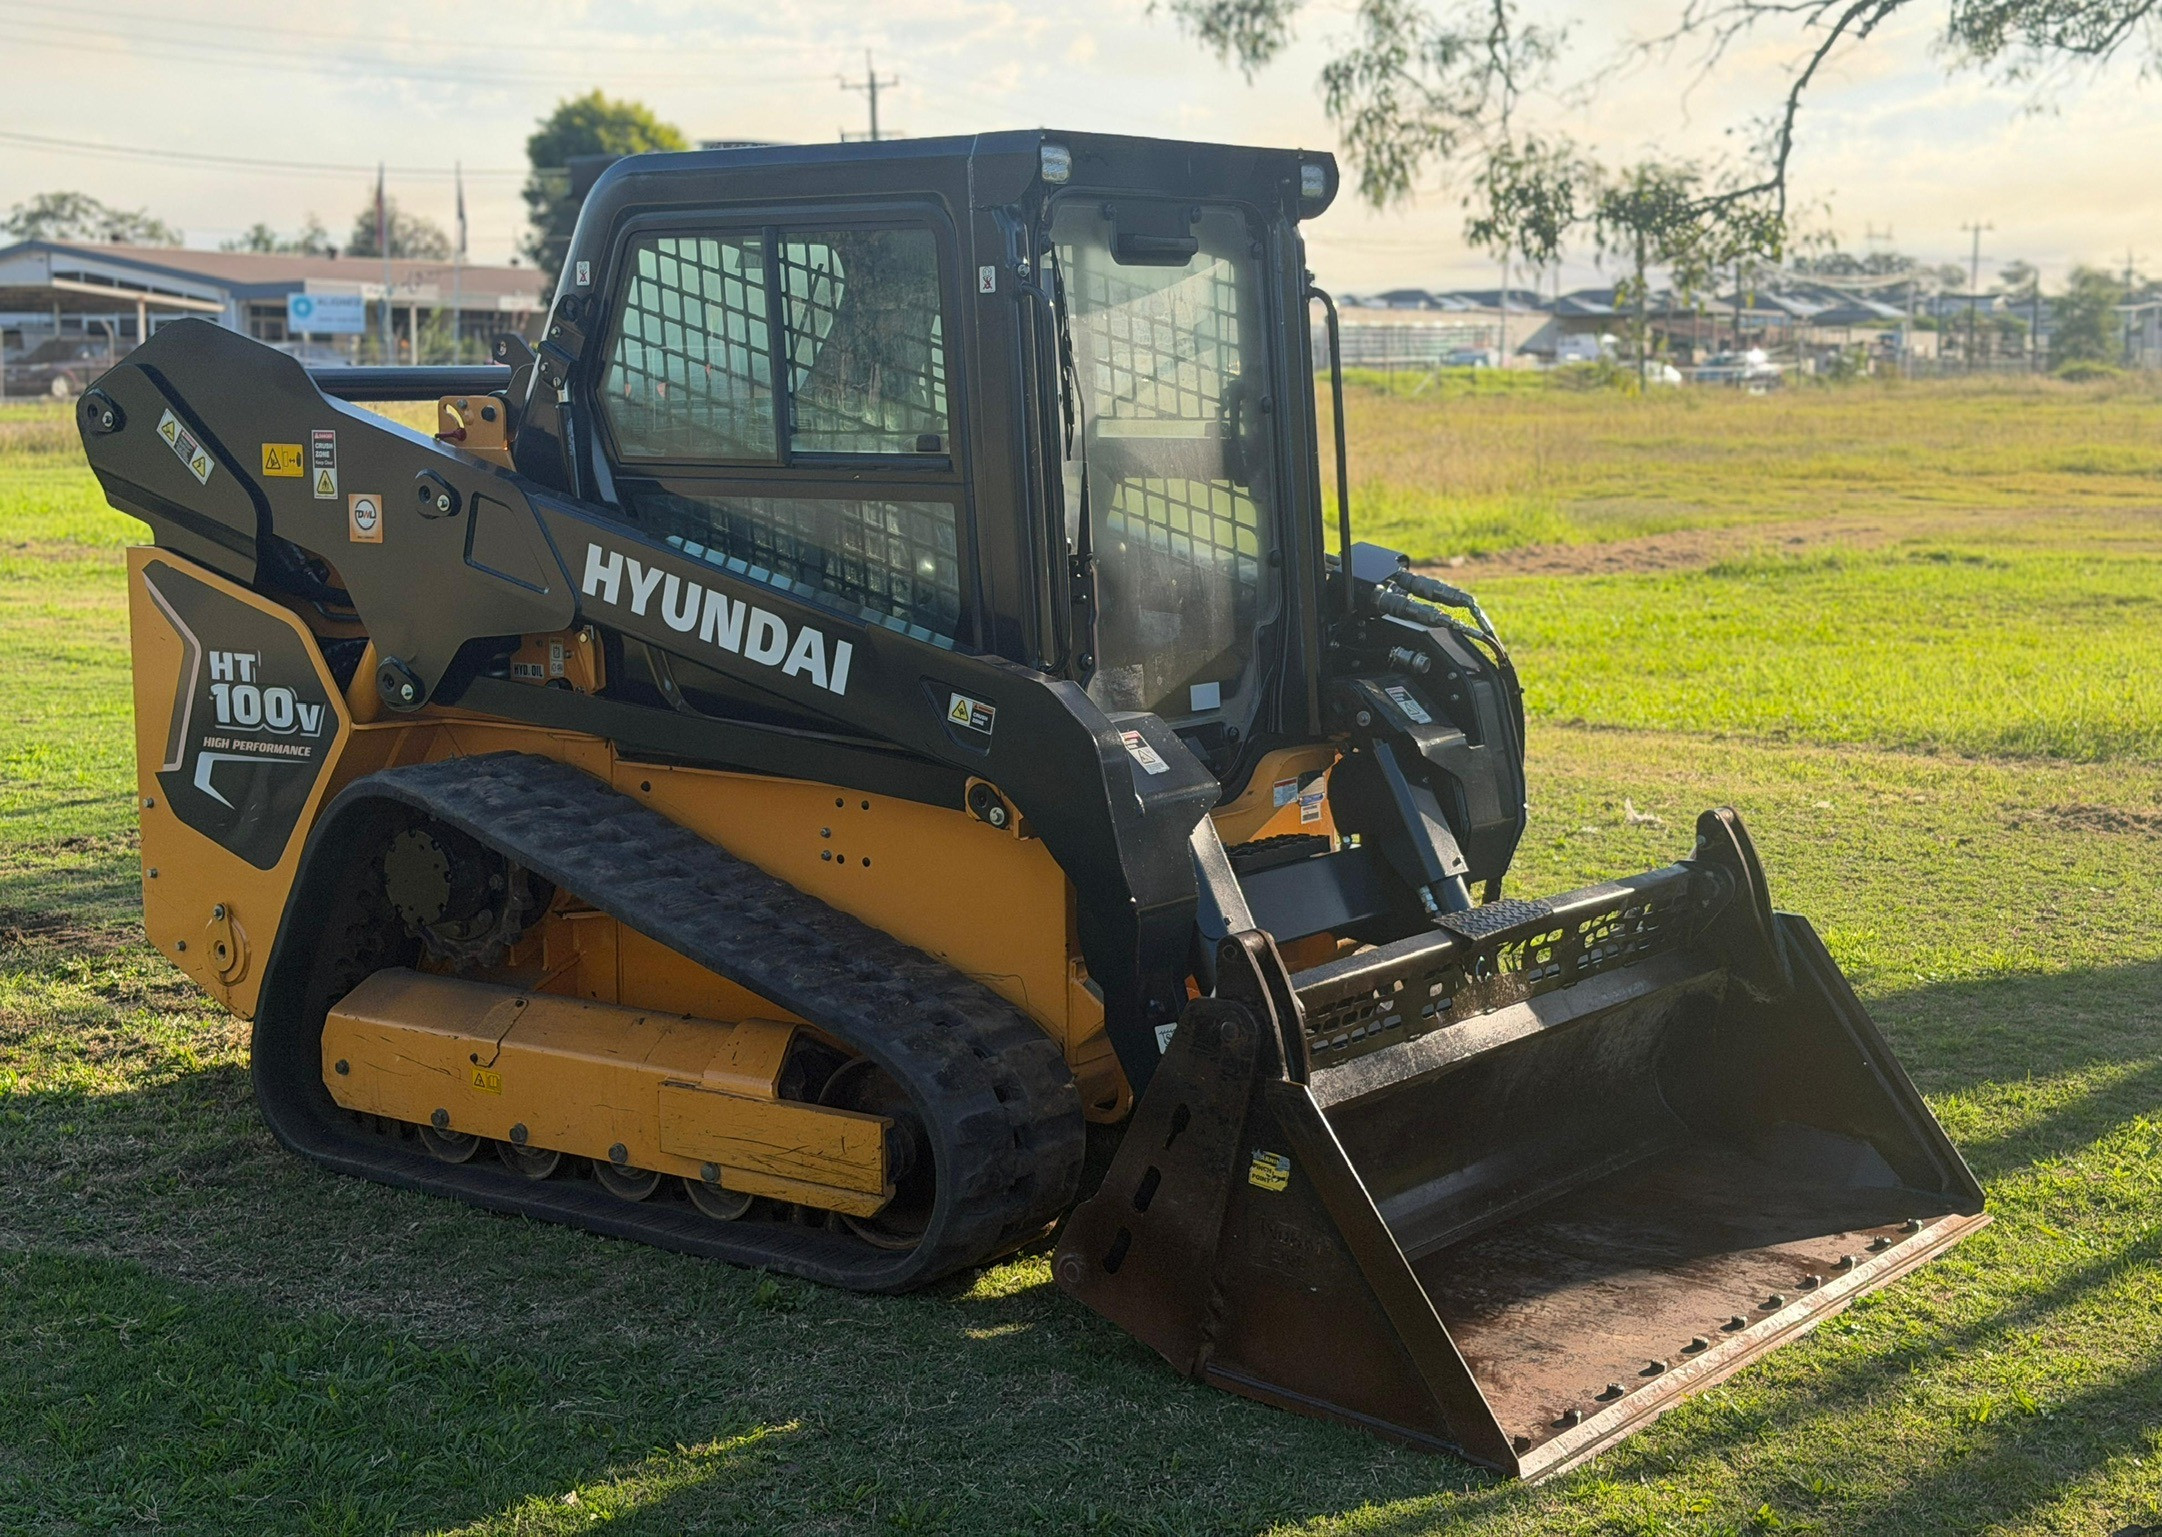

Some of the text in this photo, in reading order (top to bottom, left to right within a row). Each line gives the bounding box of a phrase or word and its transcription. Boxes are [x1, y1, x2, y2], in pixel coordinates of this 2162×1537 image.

[315, 450, 330, 458] ZONE
[582, 543, 853, 696] HYUNDAI
[209, 651, 256, 682] HT
[203, 736, 311, 757] HIGH PERFORMANCE
[1251, 1173, 1272, 1183] POINT
